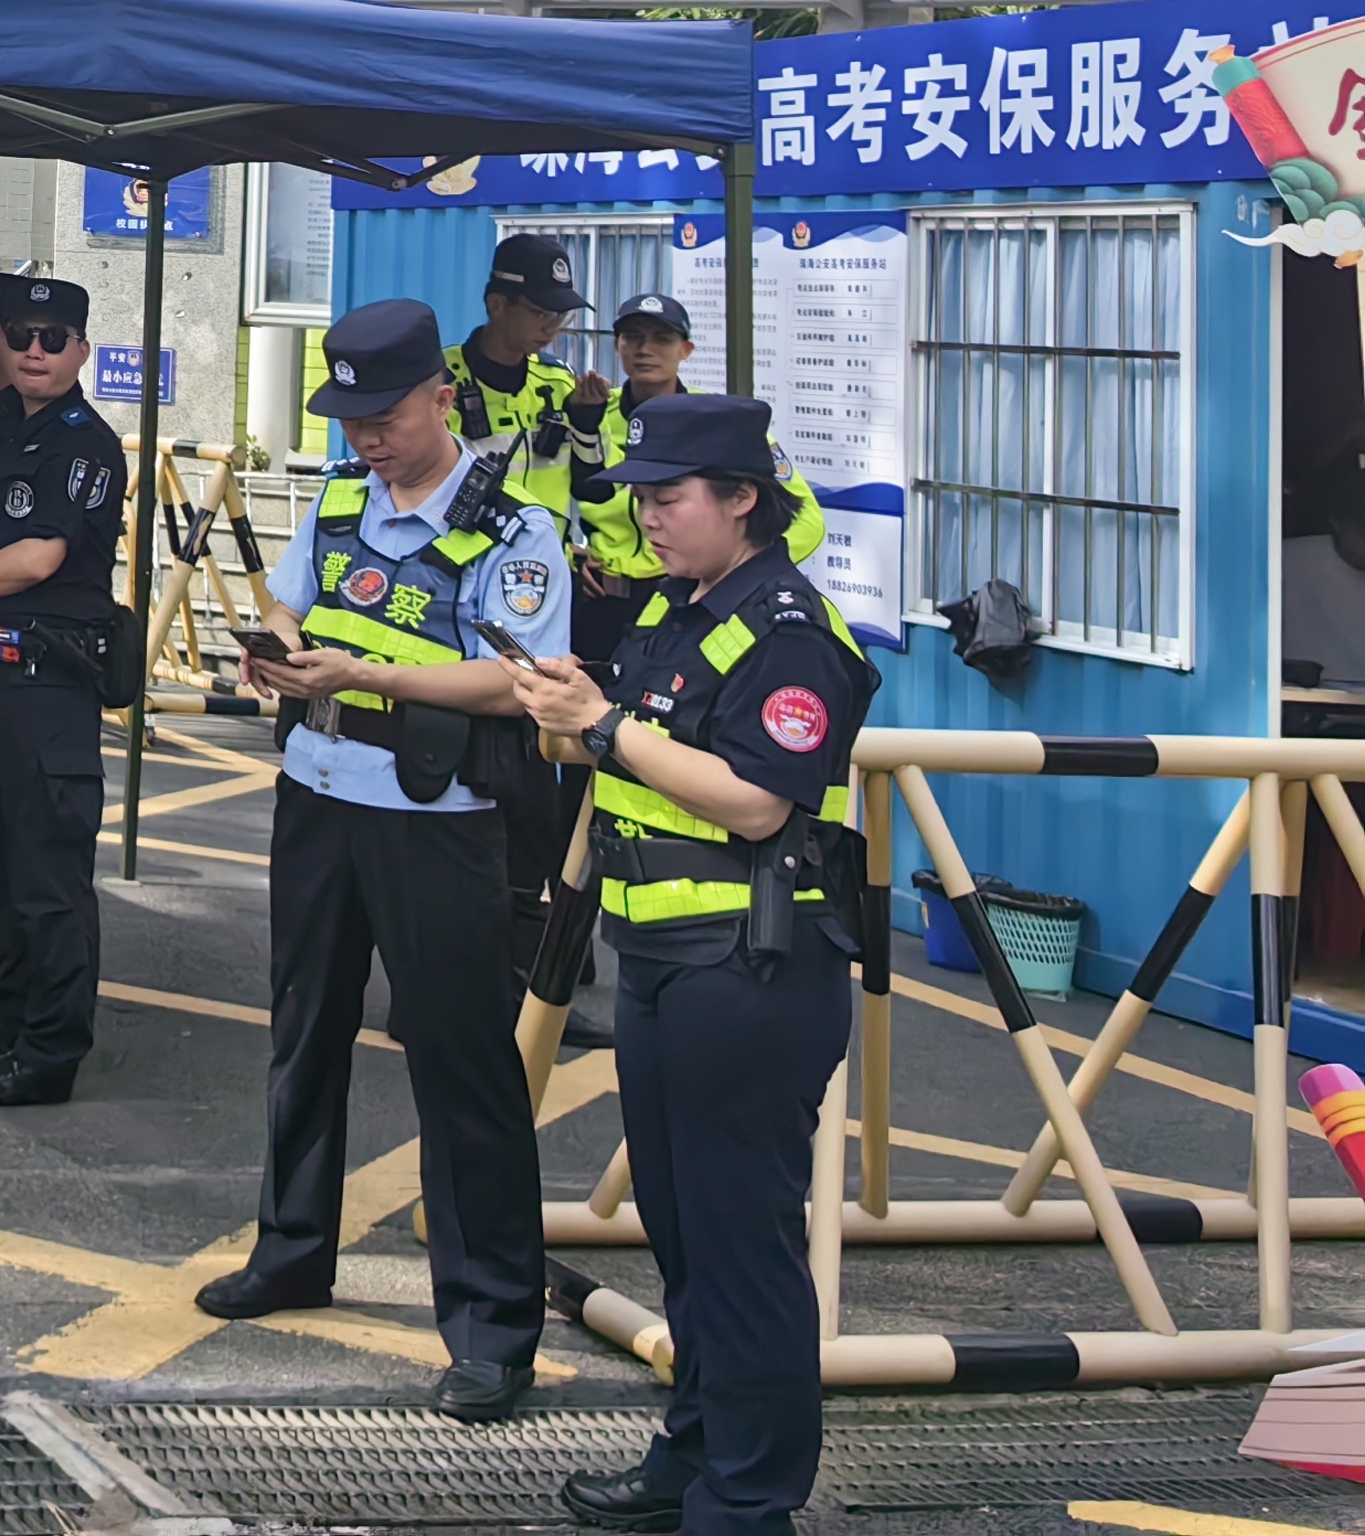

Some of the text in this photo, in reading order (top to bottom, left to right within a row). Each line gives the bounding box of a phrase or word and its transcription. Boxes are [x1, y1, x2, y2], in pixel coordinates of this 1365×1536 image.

[757, 17, 1330, 167] 高考安保服务
[115, 218, 174, 231] 校园执点
[102, 369, 164, 386] 最小应急
